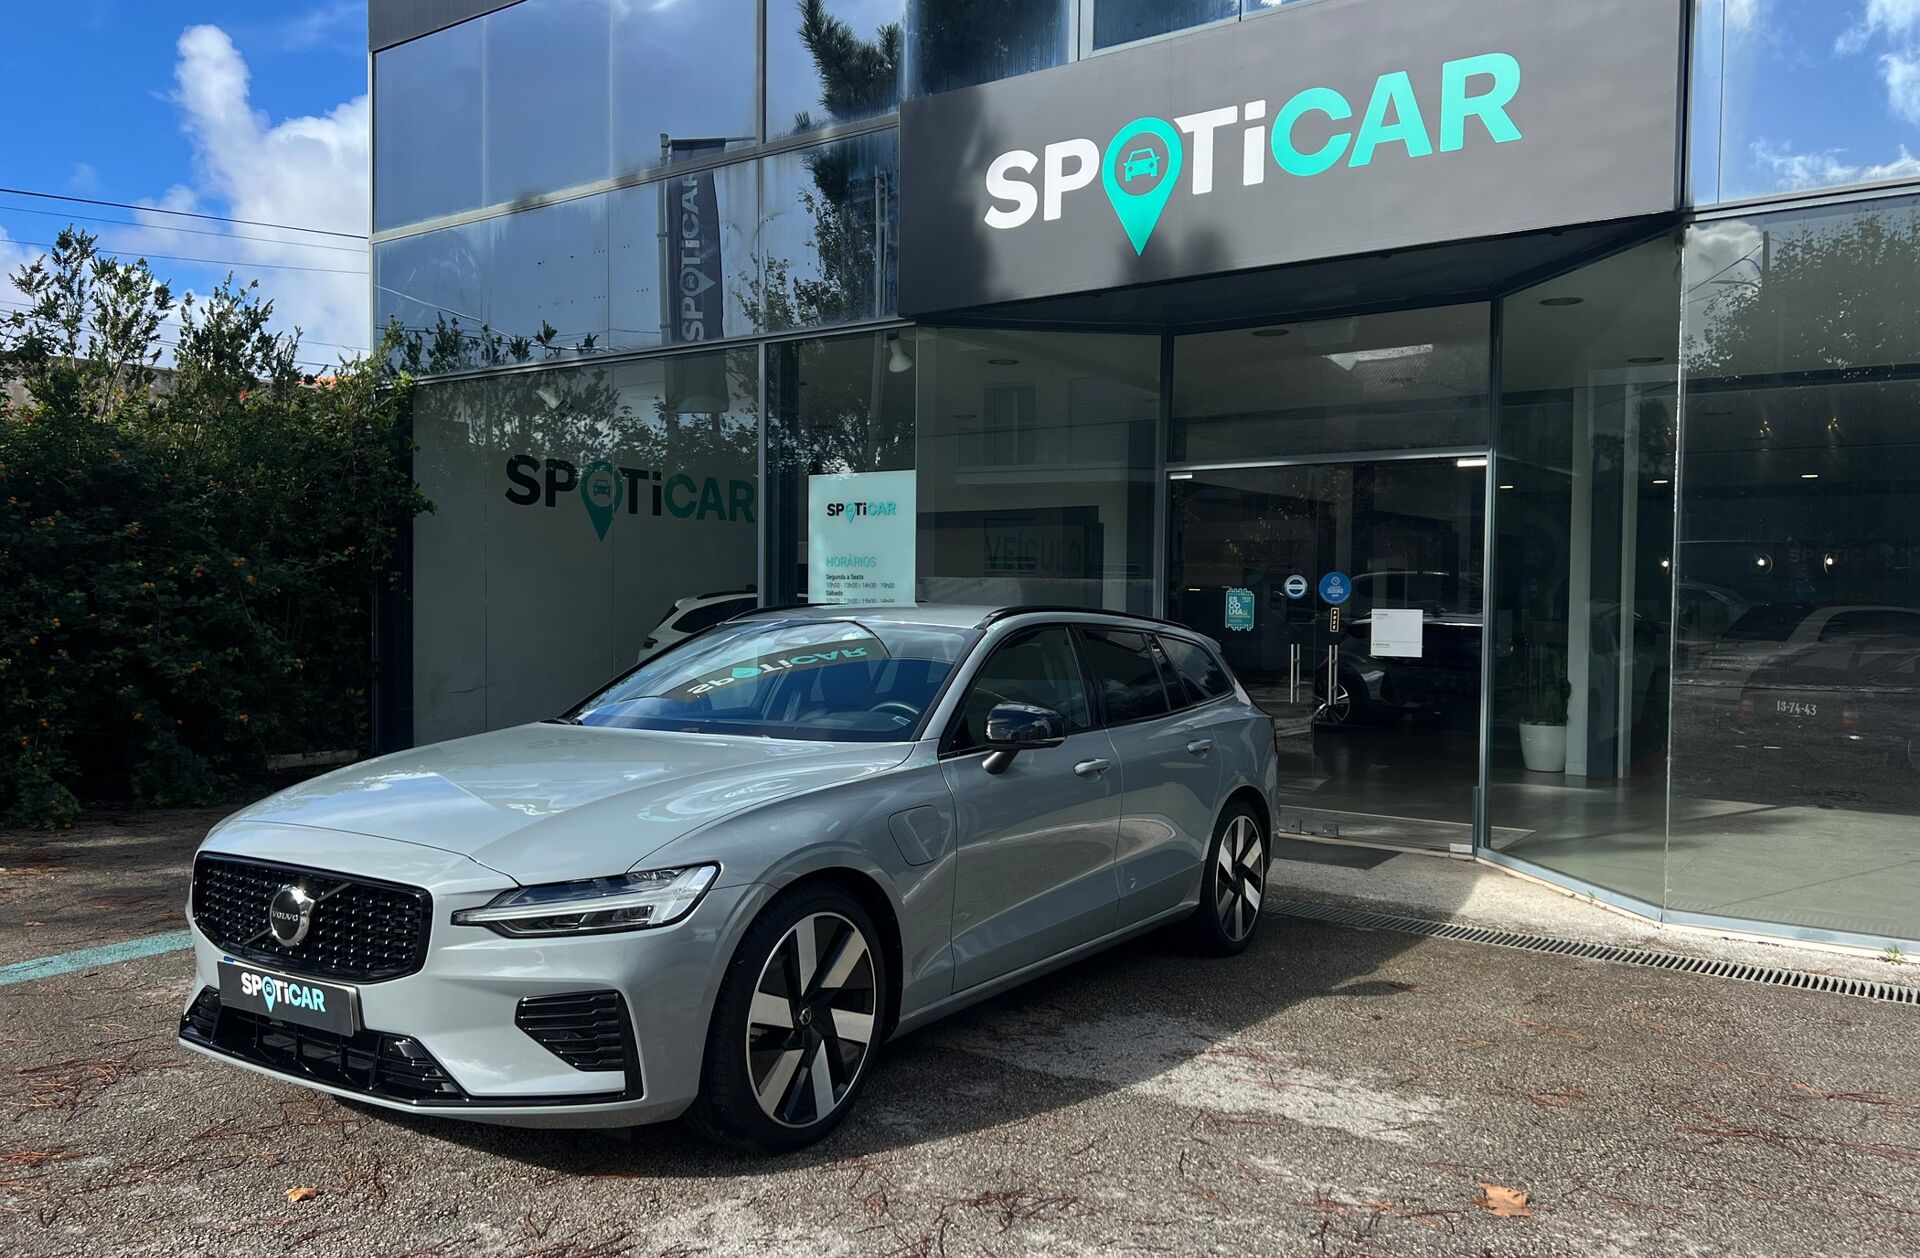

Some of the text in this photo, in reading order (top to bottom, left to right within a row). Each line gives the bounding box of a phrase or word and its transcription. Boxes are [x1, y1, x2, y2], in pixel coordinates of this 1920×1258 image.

[983, 52, 1523, 256] SPOTiCAR
[504, 454, 755, 542] SPOTiCAR
[826, 501, 897, 524] SPOTiCAR
[826, 554, 877, 568] HORÁRIOS
[272, 910, 299, 922] VOLVO
[240, 971, 327, 1014] SPOTiCAR
